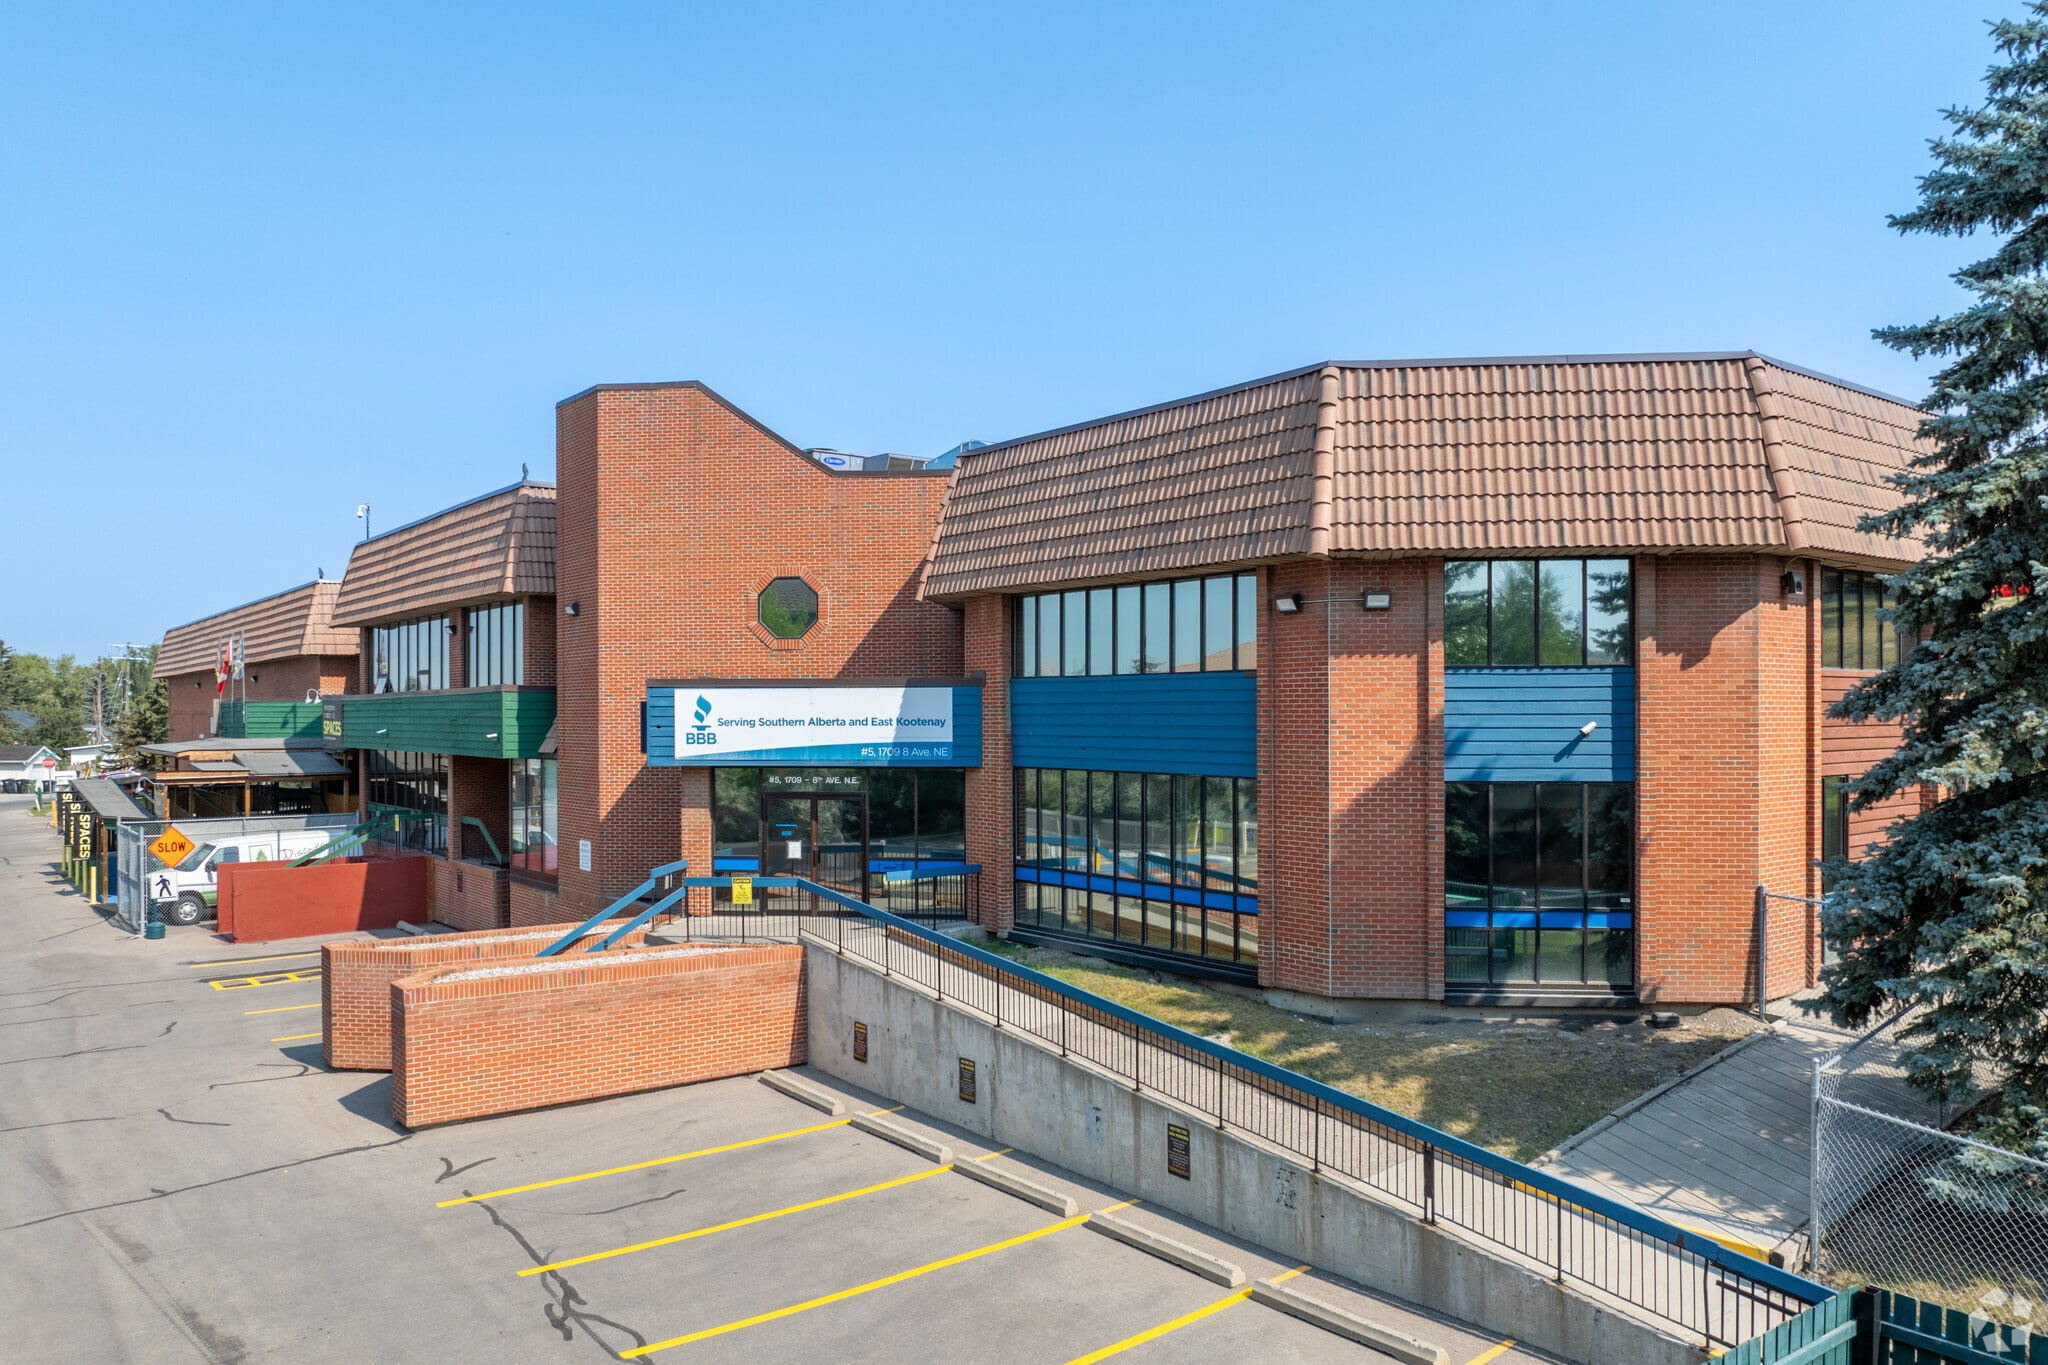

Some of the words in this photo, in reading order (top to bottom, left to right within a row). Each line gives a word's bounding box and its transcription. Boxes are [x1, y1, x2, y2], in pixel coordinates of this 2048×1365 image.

[717, 717, 756, 728] Serving
[758, 717, 805, 727] Southern
[808, 716, 846, 727] Alberta
[848, 716, 868, 727] and
[871, 717, 893, 727] East
[896, 717, 946, 728] Kootenay
[685, 732, 717, 745] BBB
[860, 747, 876, 757] #5,
[878, 747, 900, 757] 1709
[902, 747, 909, 756] 8
[911, 747, 931, 756] Ave.
[933, 747, 948, 756] NE
[769, 776, 782, 784] #5,
[784, 776, 802, 784] 1709
[825, 776, 842, 784] AVE.
[844, 776, 860, 784] N.E.
[79, 814, 91, 859] SPACES
[157, 842, 186, 853] SLOW
